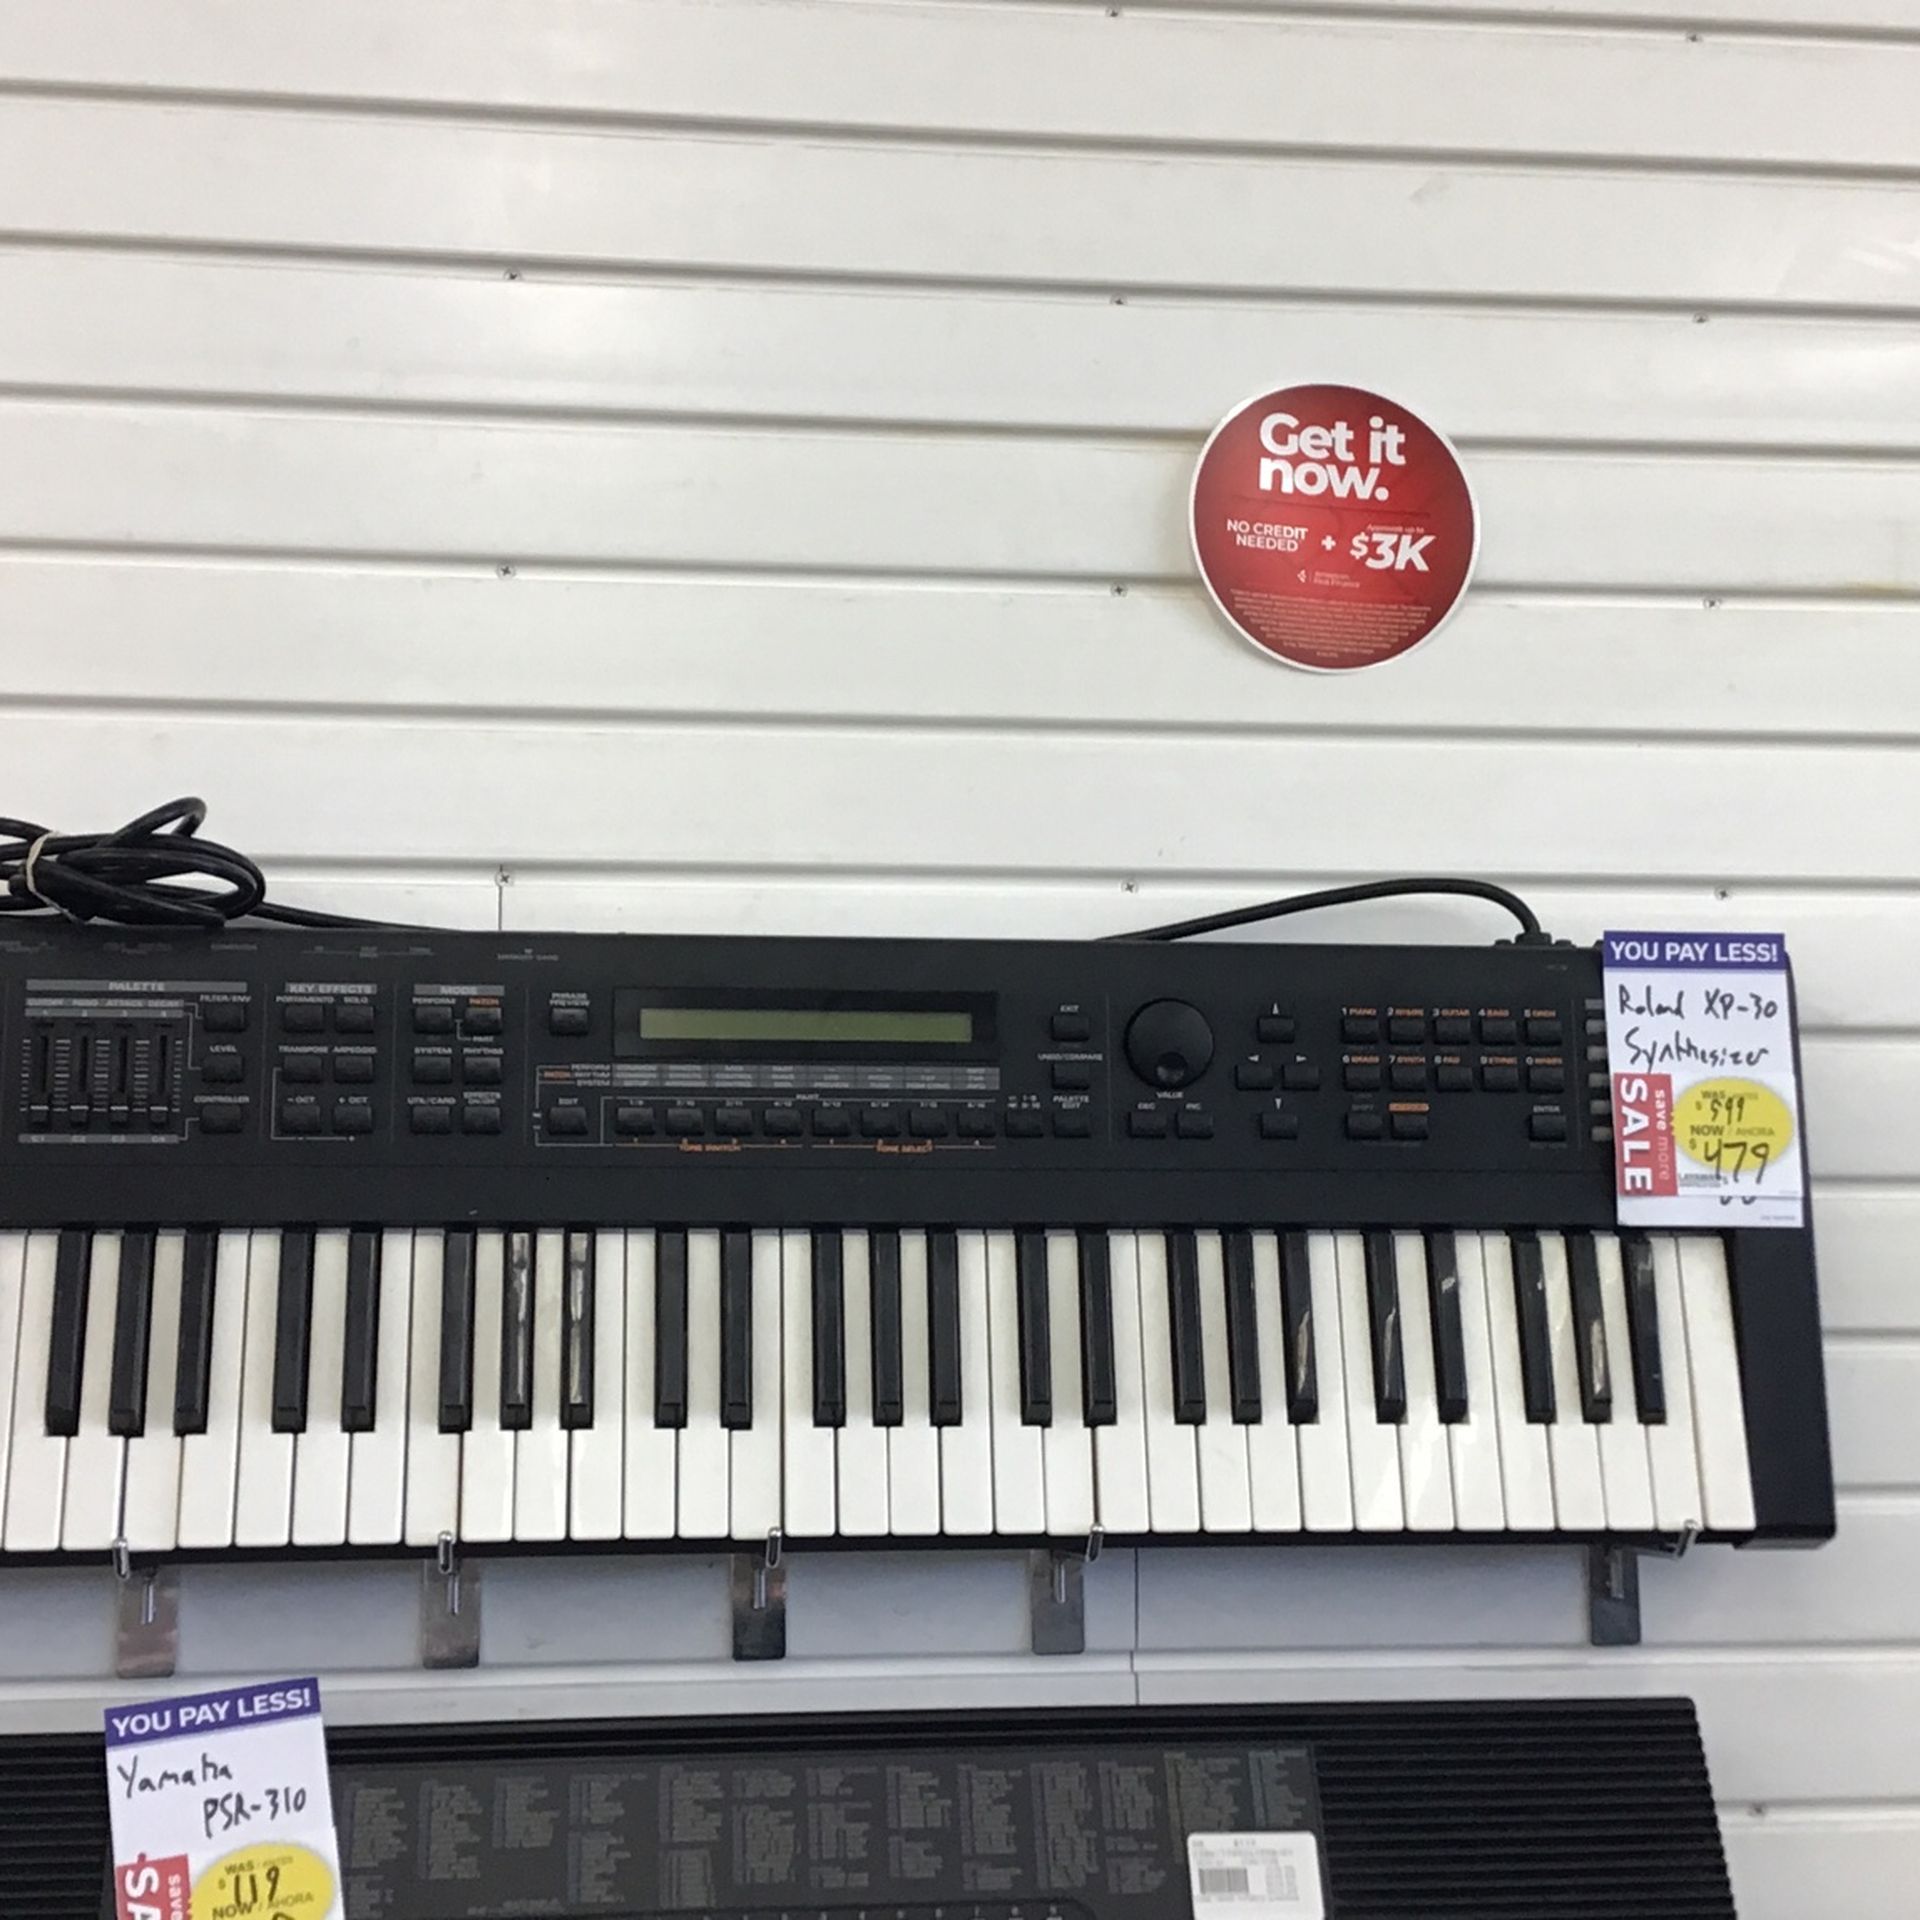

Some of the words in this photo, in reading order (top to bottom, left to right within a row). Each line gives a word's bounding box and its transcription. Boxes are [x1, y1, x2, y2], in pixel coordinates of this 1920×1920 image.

[1260, 412, 1355, 462] Get
[1369, 416, 1406, 465] it
[1259, 457, 1389, 501] now.
[1226, 519, 1250, 534] NO
[1253, 523, 1308, 541] CREDIT
[1236, 534, 1298, 552] NEEDED
[1349, 532, 1437, 572] $3K
[1610, 941, 1658, 960] YOU
[1665, 942, 1708, 961] PAY
[1715, 943, 1778, 962] LESS!
[108, 981, 166, 991] PALETTE
[289, 984, 314, 994] KEY
[319, 985, 372, 994] EFFECTS
[1618, 984, 1685, 1020] Roland
[1704, 987, 1778, 1020] XP-30
[1625, 1026, 1769, 1073] Synthesizer
[1654, 1089, 1667, 1131] save
[1701, 1090, 1726, 1099] WAS
[1620, 1077, 1653, 1191] SALE
[1690, 1125, 1725, 1136] NOW
[1658, 1136, 1670, 1181] more
[1704, 1138, 1769, 1184] 479
[112, 1710, 171, 1738] YOU
[179, 1700, 230, 1727] PAY
[237, 1688, 311, 1718] LESS!
[117, 1752, 233, 1799] Yamaha
[203, 1787, 306, 1839] PSR-310
[225, 1860, 255, 1875] WAS
[234, 1865, 279, 1906] 119
[212, 1902, 253, 1920] NOW
